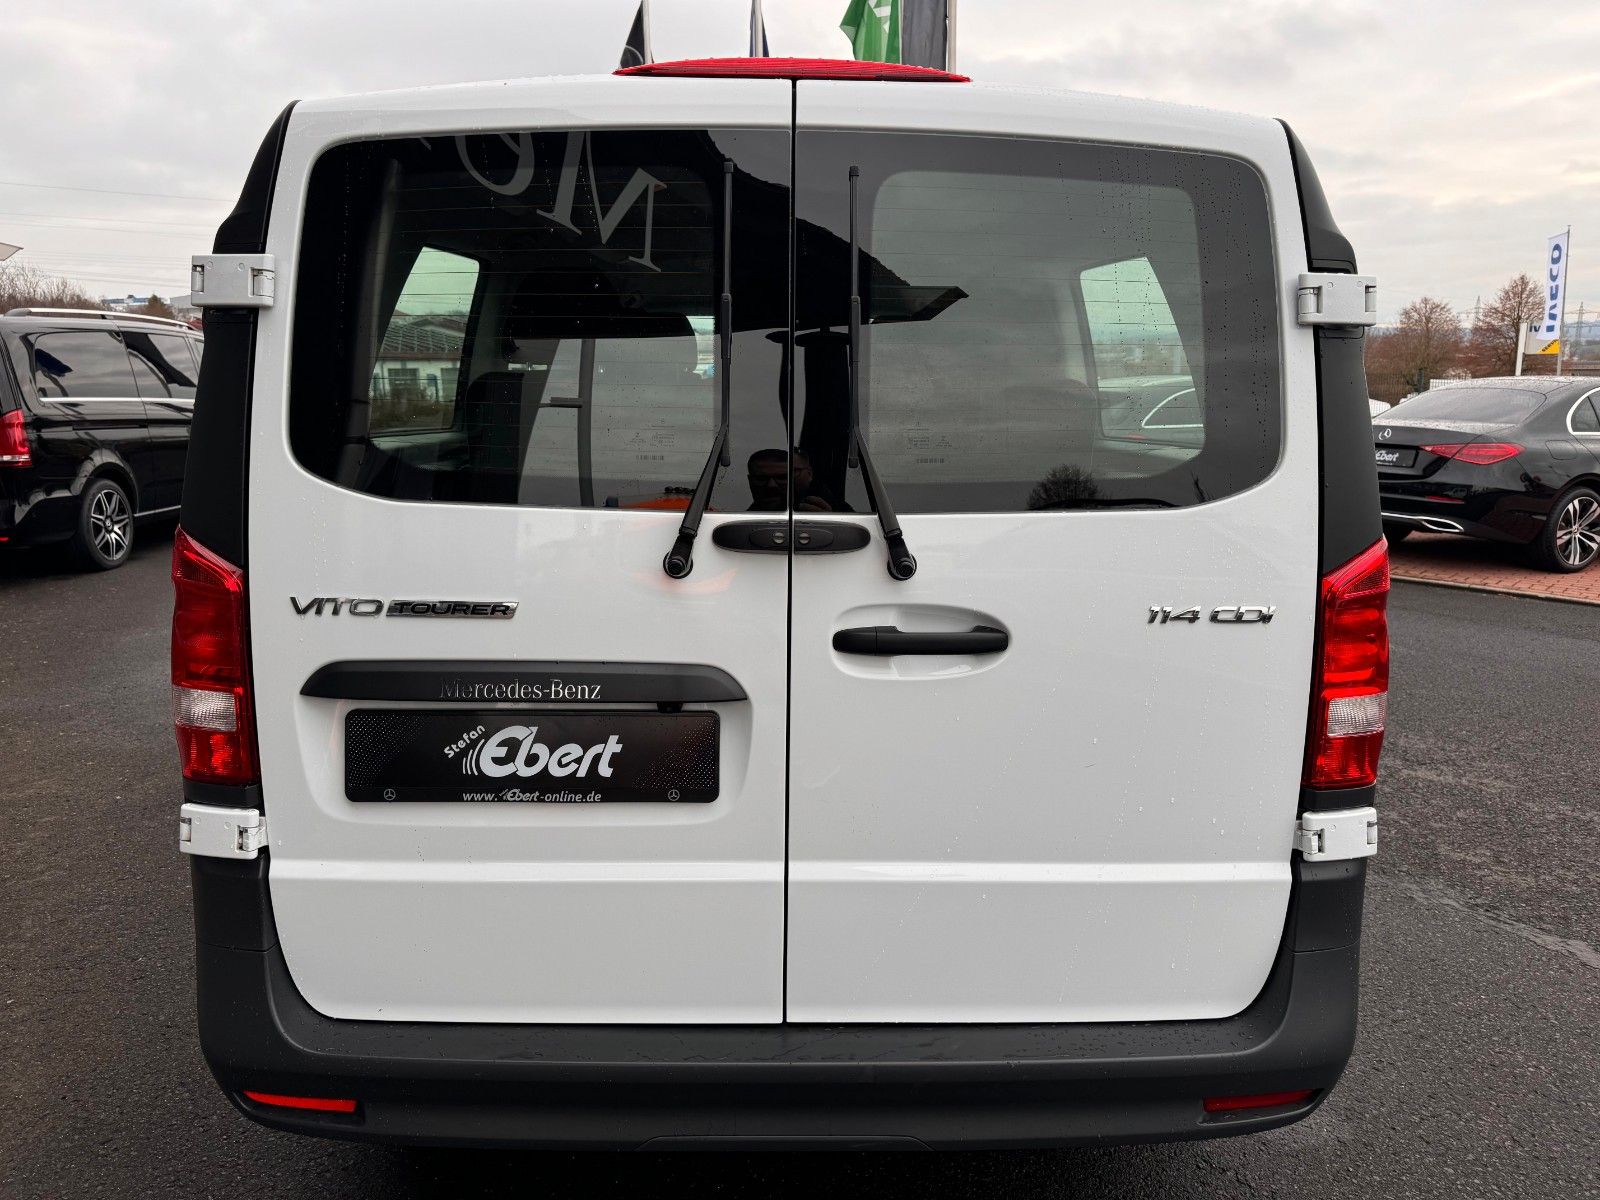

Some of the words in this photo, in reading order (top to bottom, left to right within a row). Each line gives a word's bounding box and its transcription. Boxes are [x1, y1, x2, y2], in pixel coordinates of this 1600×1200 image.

[1545, 243, 1562, 333] IVECO
[289, 596, 385, 617] VITO
[391, 601, 513, 617] TOURER
[1147, 605, 1202, 624] 114
[1209, 605, 1276, 624] CDI
[440, 679, 602, 699] Mercedes-Benz
[443, 724, 486, 759] Stefan
[478, 724, 624, 778] Ebert
